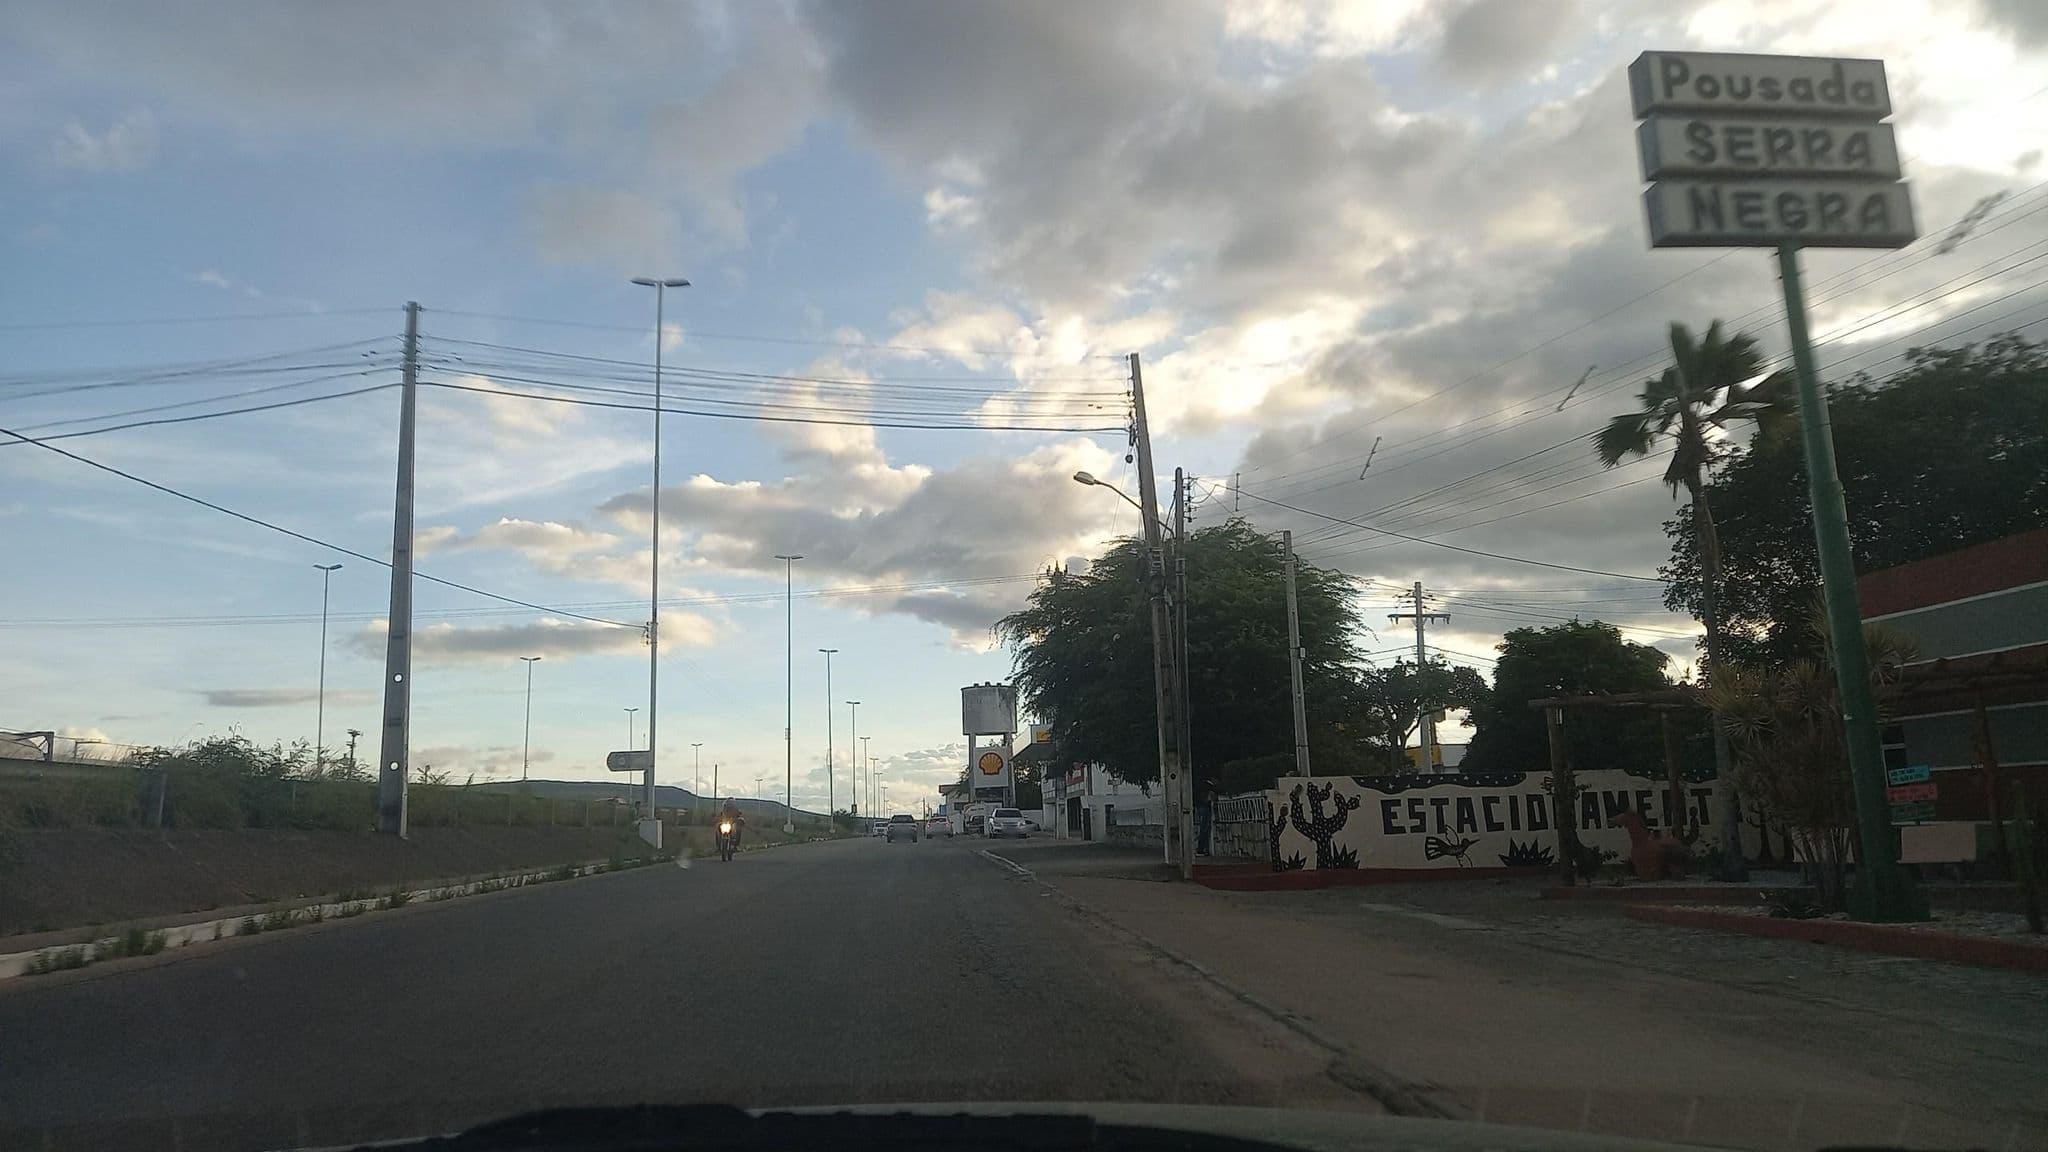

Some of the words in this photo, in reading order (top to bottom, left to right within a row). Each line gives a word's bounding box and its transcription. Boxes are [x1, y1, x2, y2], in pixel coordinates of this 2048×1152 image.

[1660, 56, 1875, 103] Pousada
[1684, 121, 1873, 168] SERRA
[1688, 187, 1890, 232] NEGRA
[1380, 787, 1743, 834] ESTACIOAMENT
